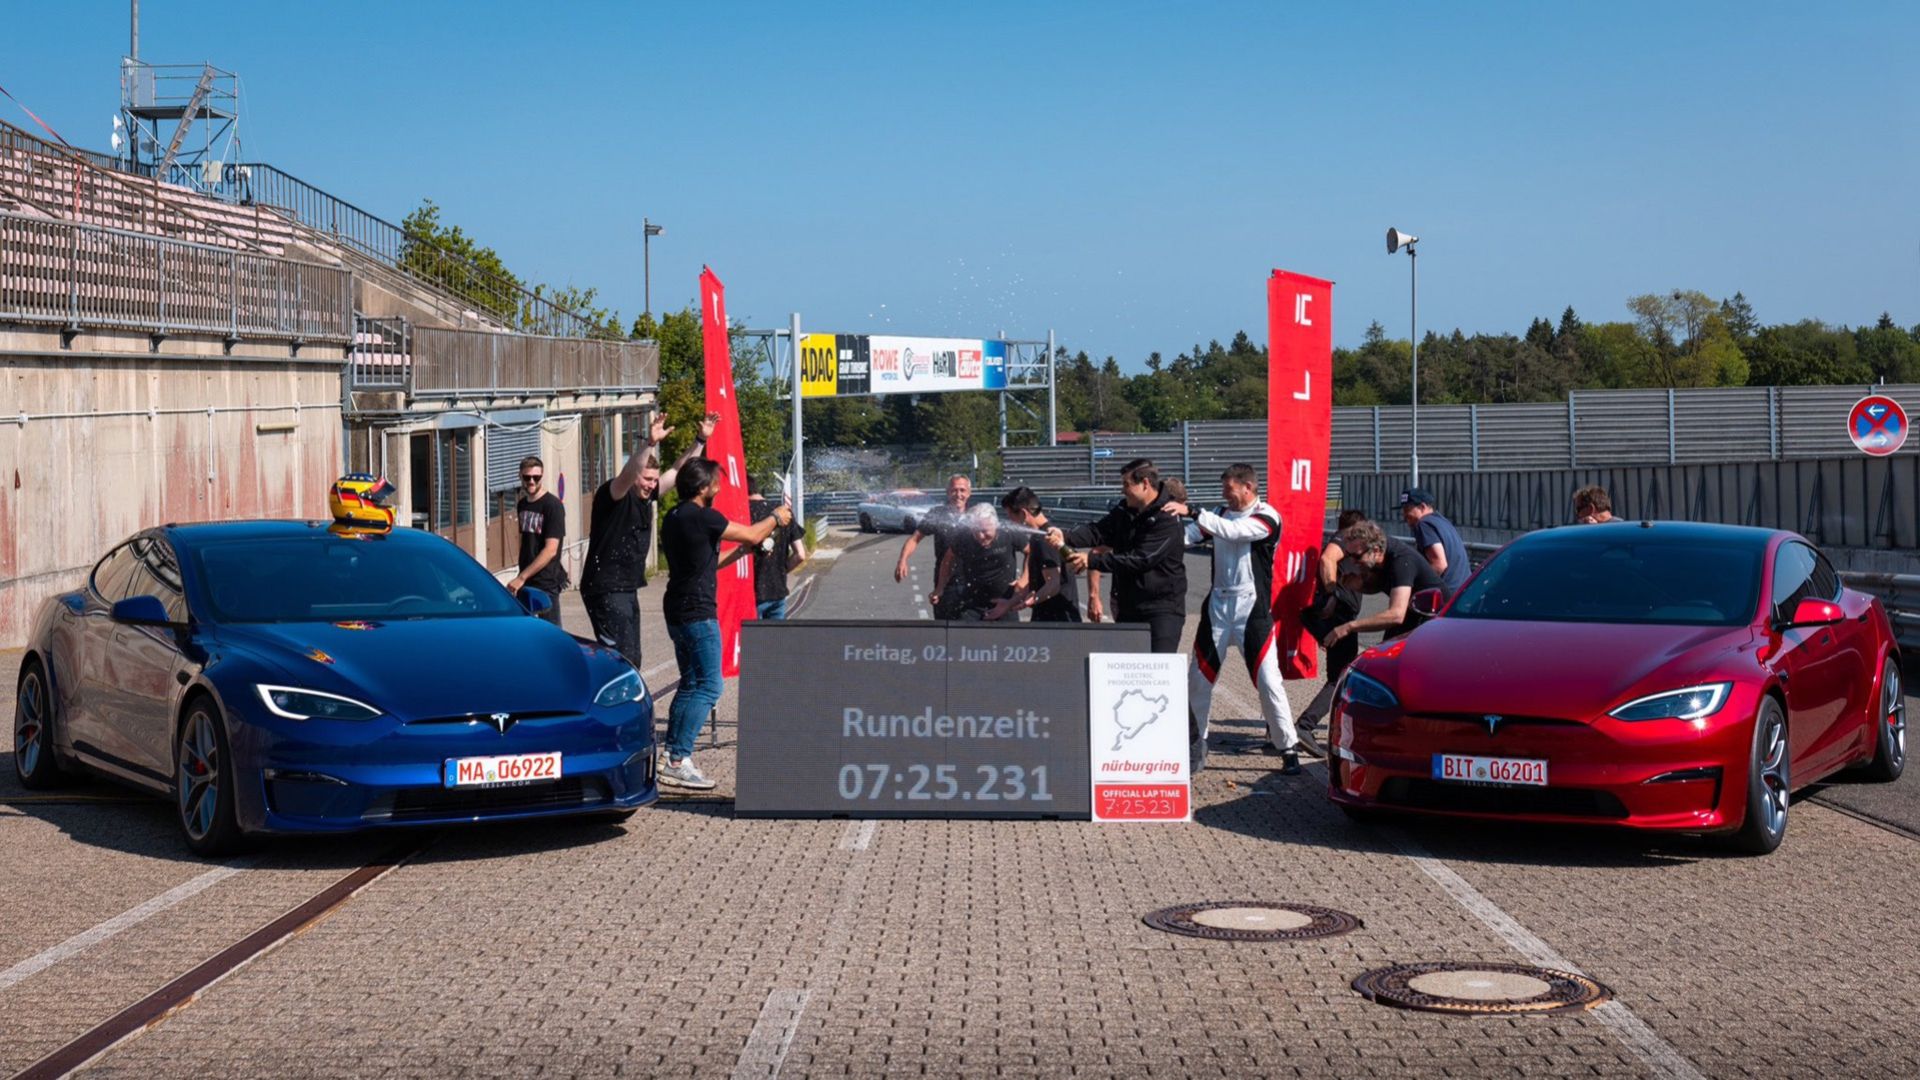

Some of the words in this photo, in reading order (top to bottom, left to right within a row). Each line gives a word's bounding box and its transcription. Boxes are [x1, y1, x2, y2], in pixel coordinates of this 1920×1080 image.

[801, 347, 834, 382] ADAC
[873, 349, 899, 370] ROWE
[844, 643, 917, 664] Freitag,
[923, 645, 953, 662] 02.
[958, 645, 997, 662] Juni
[1003, 646, 1050, 663] 2023
[1107, 662, 1170, 670] NORDSCHLEIFE
[842, 706, 1050, 739] Rundenzeit:
[459, 761, 485, 782] MA
[498, 757, 555, 779] 06922
[1101, 760, 1180, 774] nürburgring
[1444, 757, 1473, 778] BIT
[1490, 760, 1544, 783] 06201
[838, 764, 1053, 800] 07:25.231
[1102, 789, 1140, 798] OFFICIAL
[1142, 789, 1158, 798] LAP
[1160, 789, 1181, 798] TIME
[1104, 798, 1176, 816] 7:25.231
